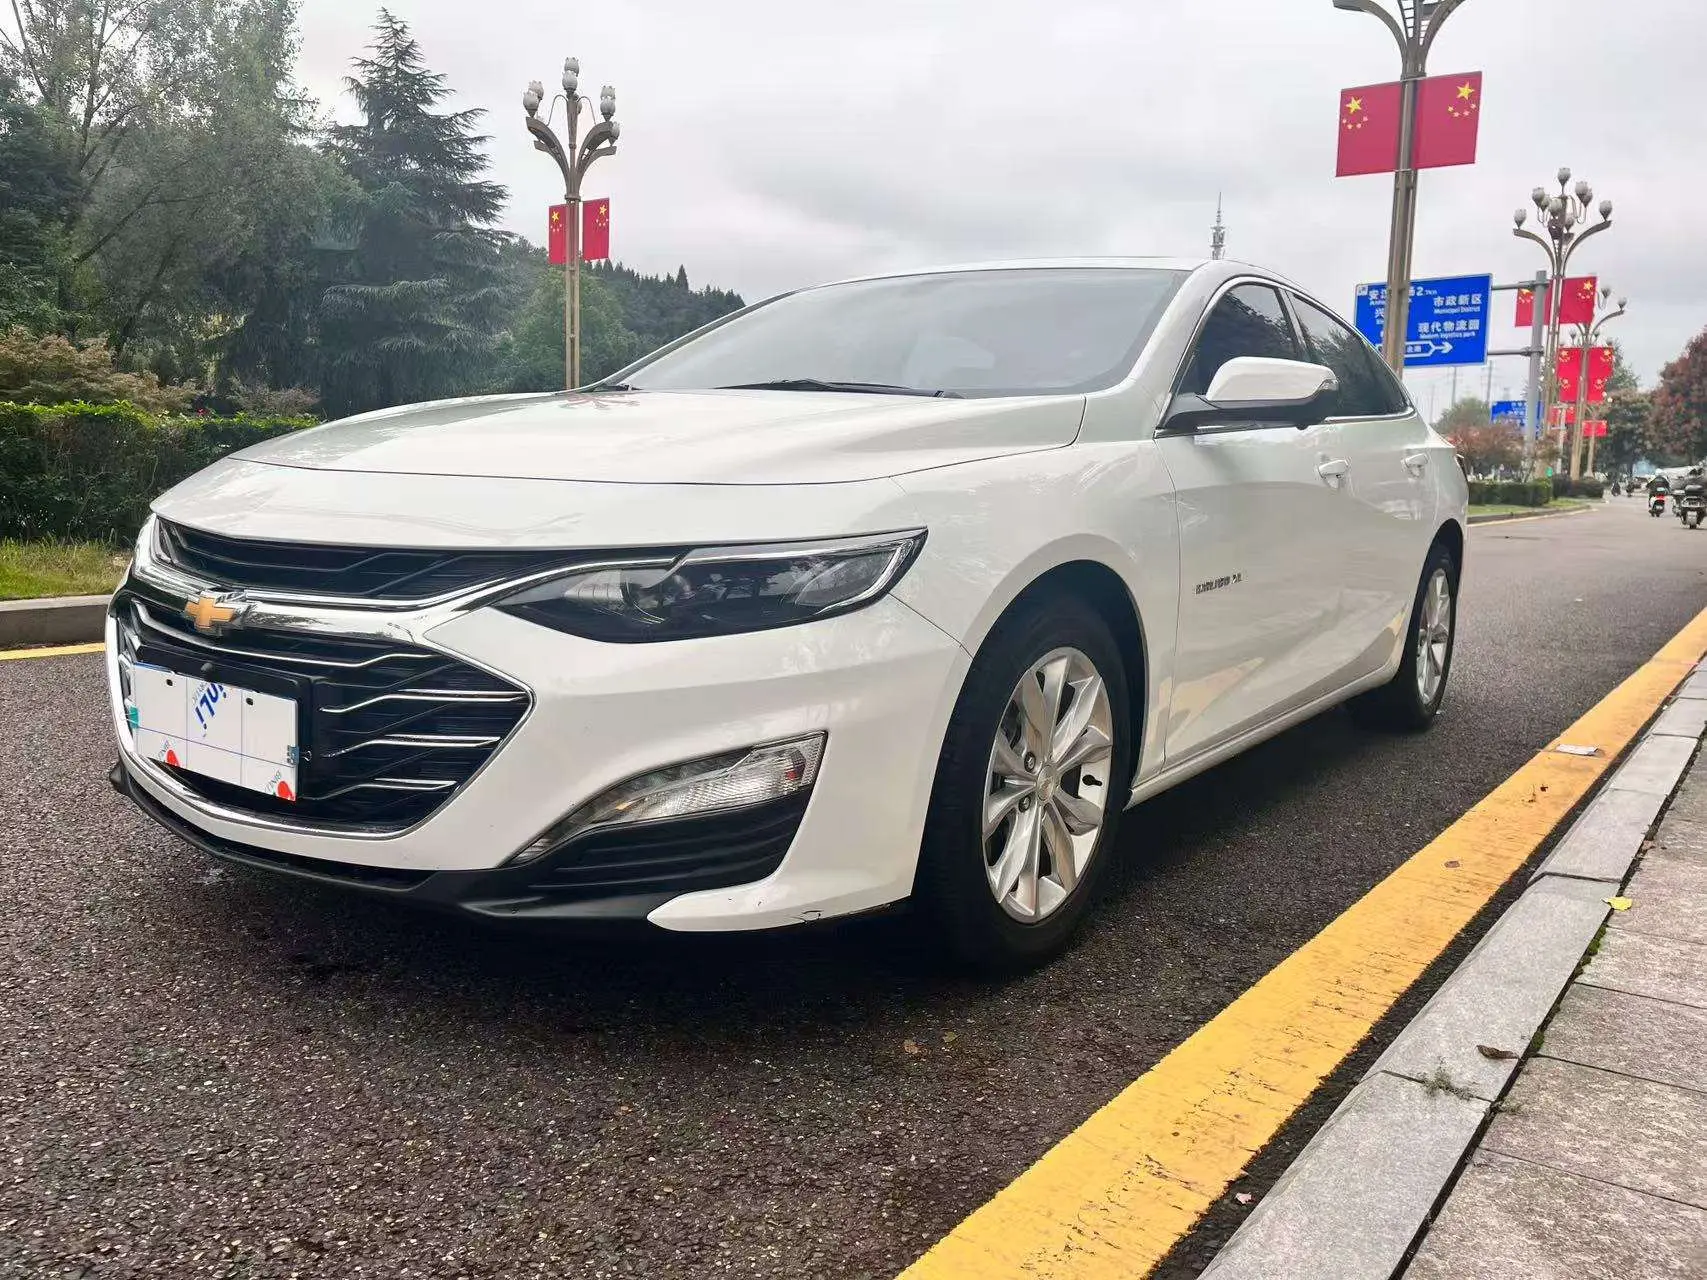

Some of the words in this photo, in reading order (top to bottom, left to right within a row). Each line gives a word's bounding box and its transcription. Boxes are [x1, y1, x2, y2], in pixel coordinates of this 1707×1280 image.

[1433, 294, 1482, 307] 市政新区
[1418, 319, 1480, 334] 现代物流园
